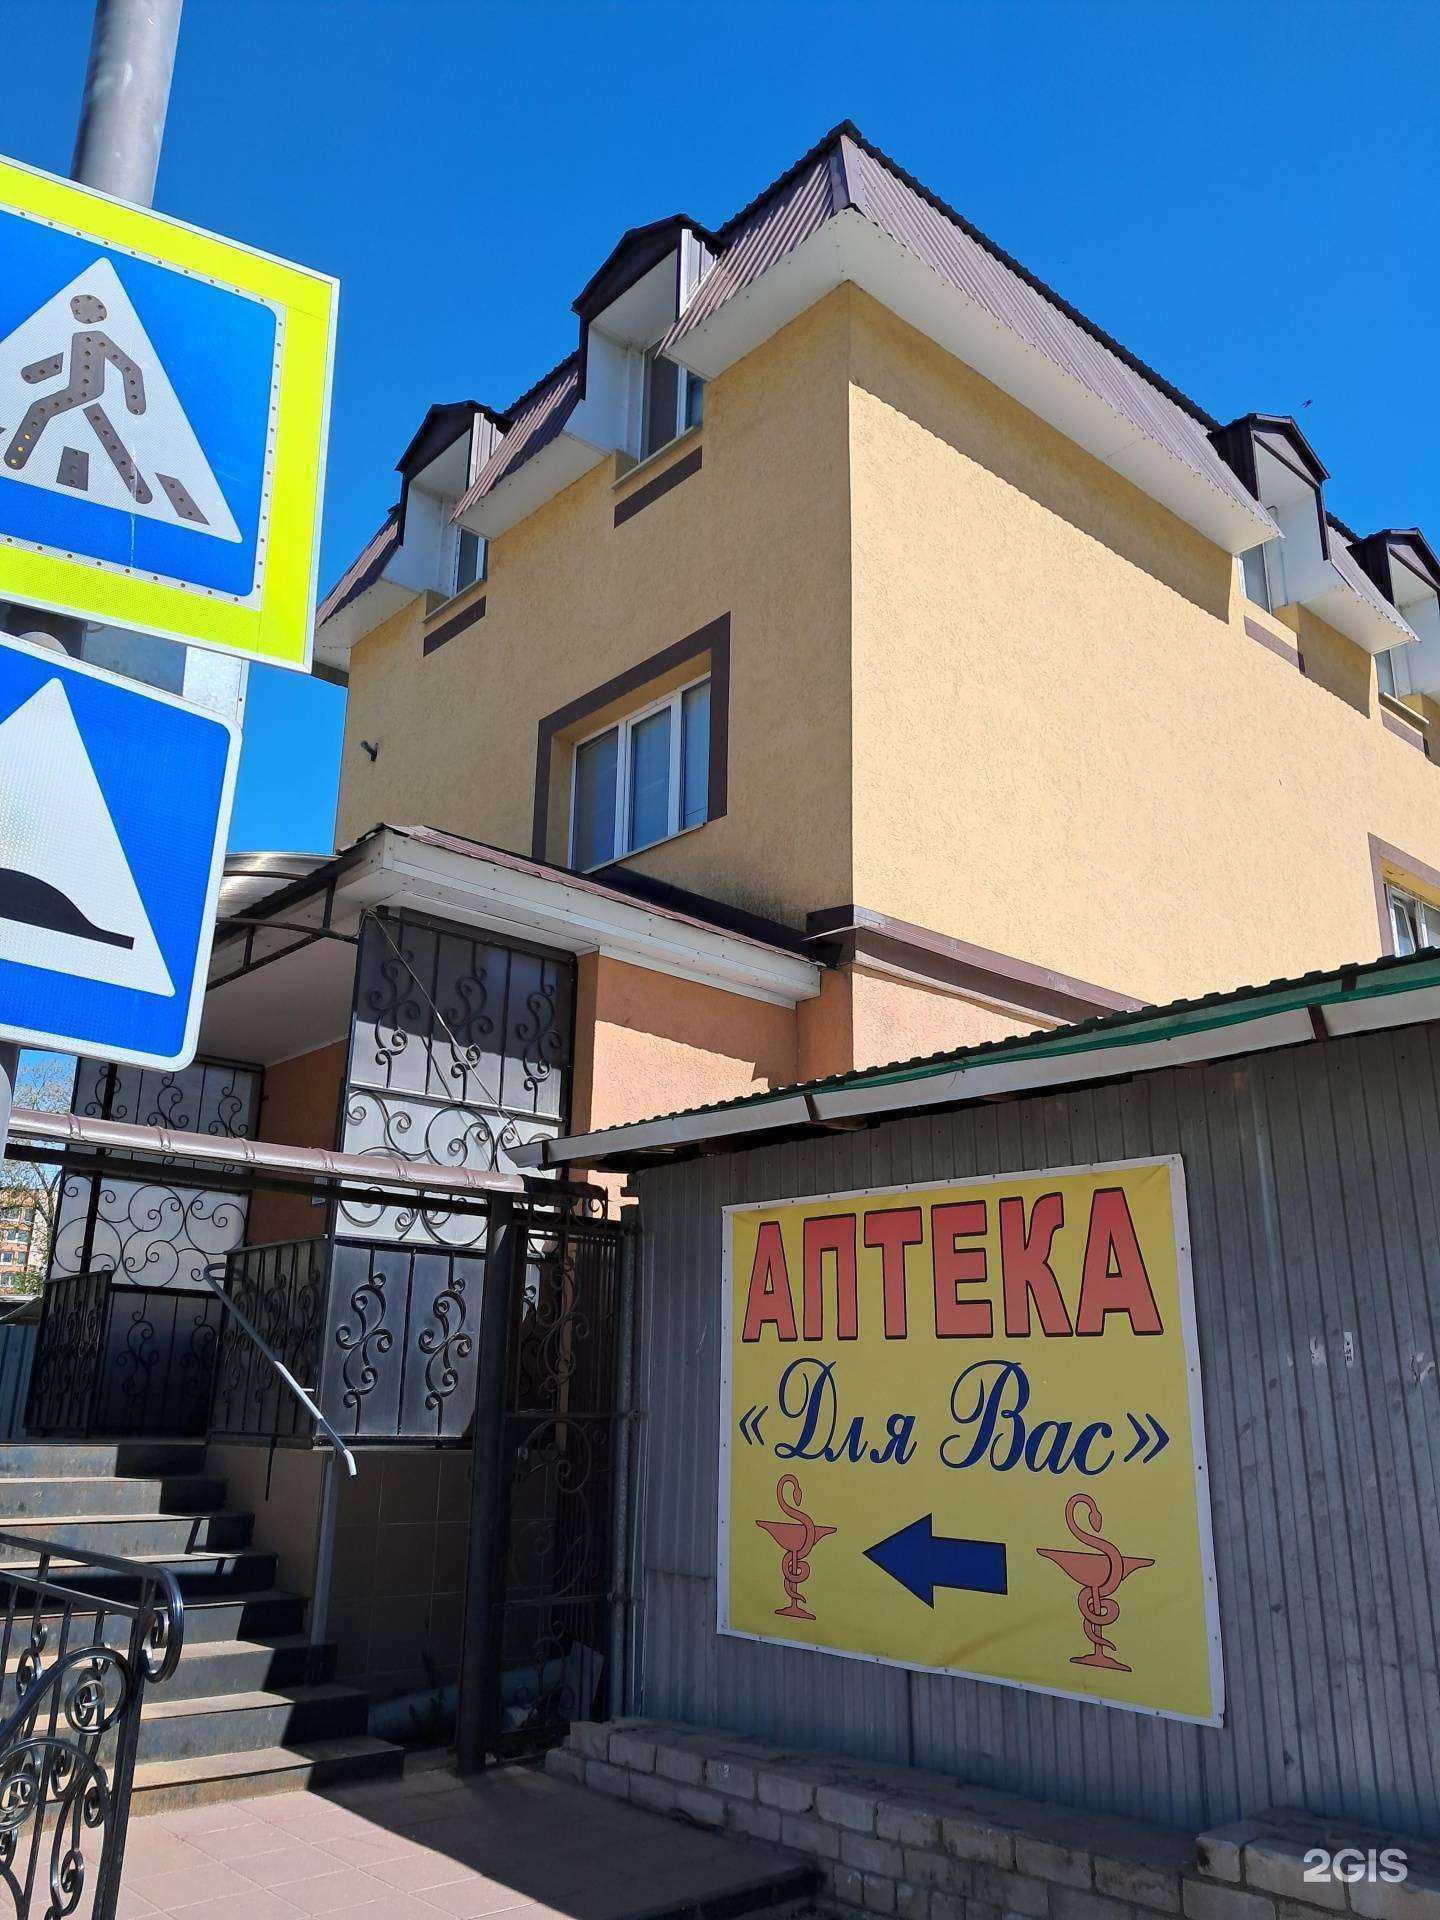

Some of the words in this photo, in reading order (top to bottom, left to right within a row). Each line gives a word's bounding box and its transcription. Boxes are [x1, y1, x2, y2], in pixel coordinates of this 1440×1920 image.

[742, 1187, 1164, 1342] АПТЕКА
[739, 1357, 917, 1465] «Для
[940, 1359, 1170, 1475] Вас»
